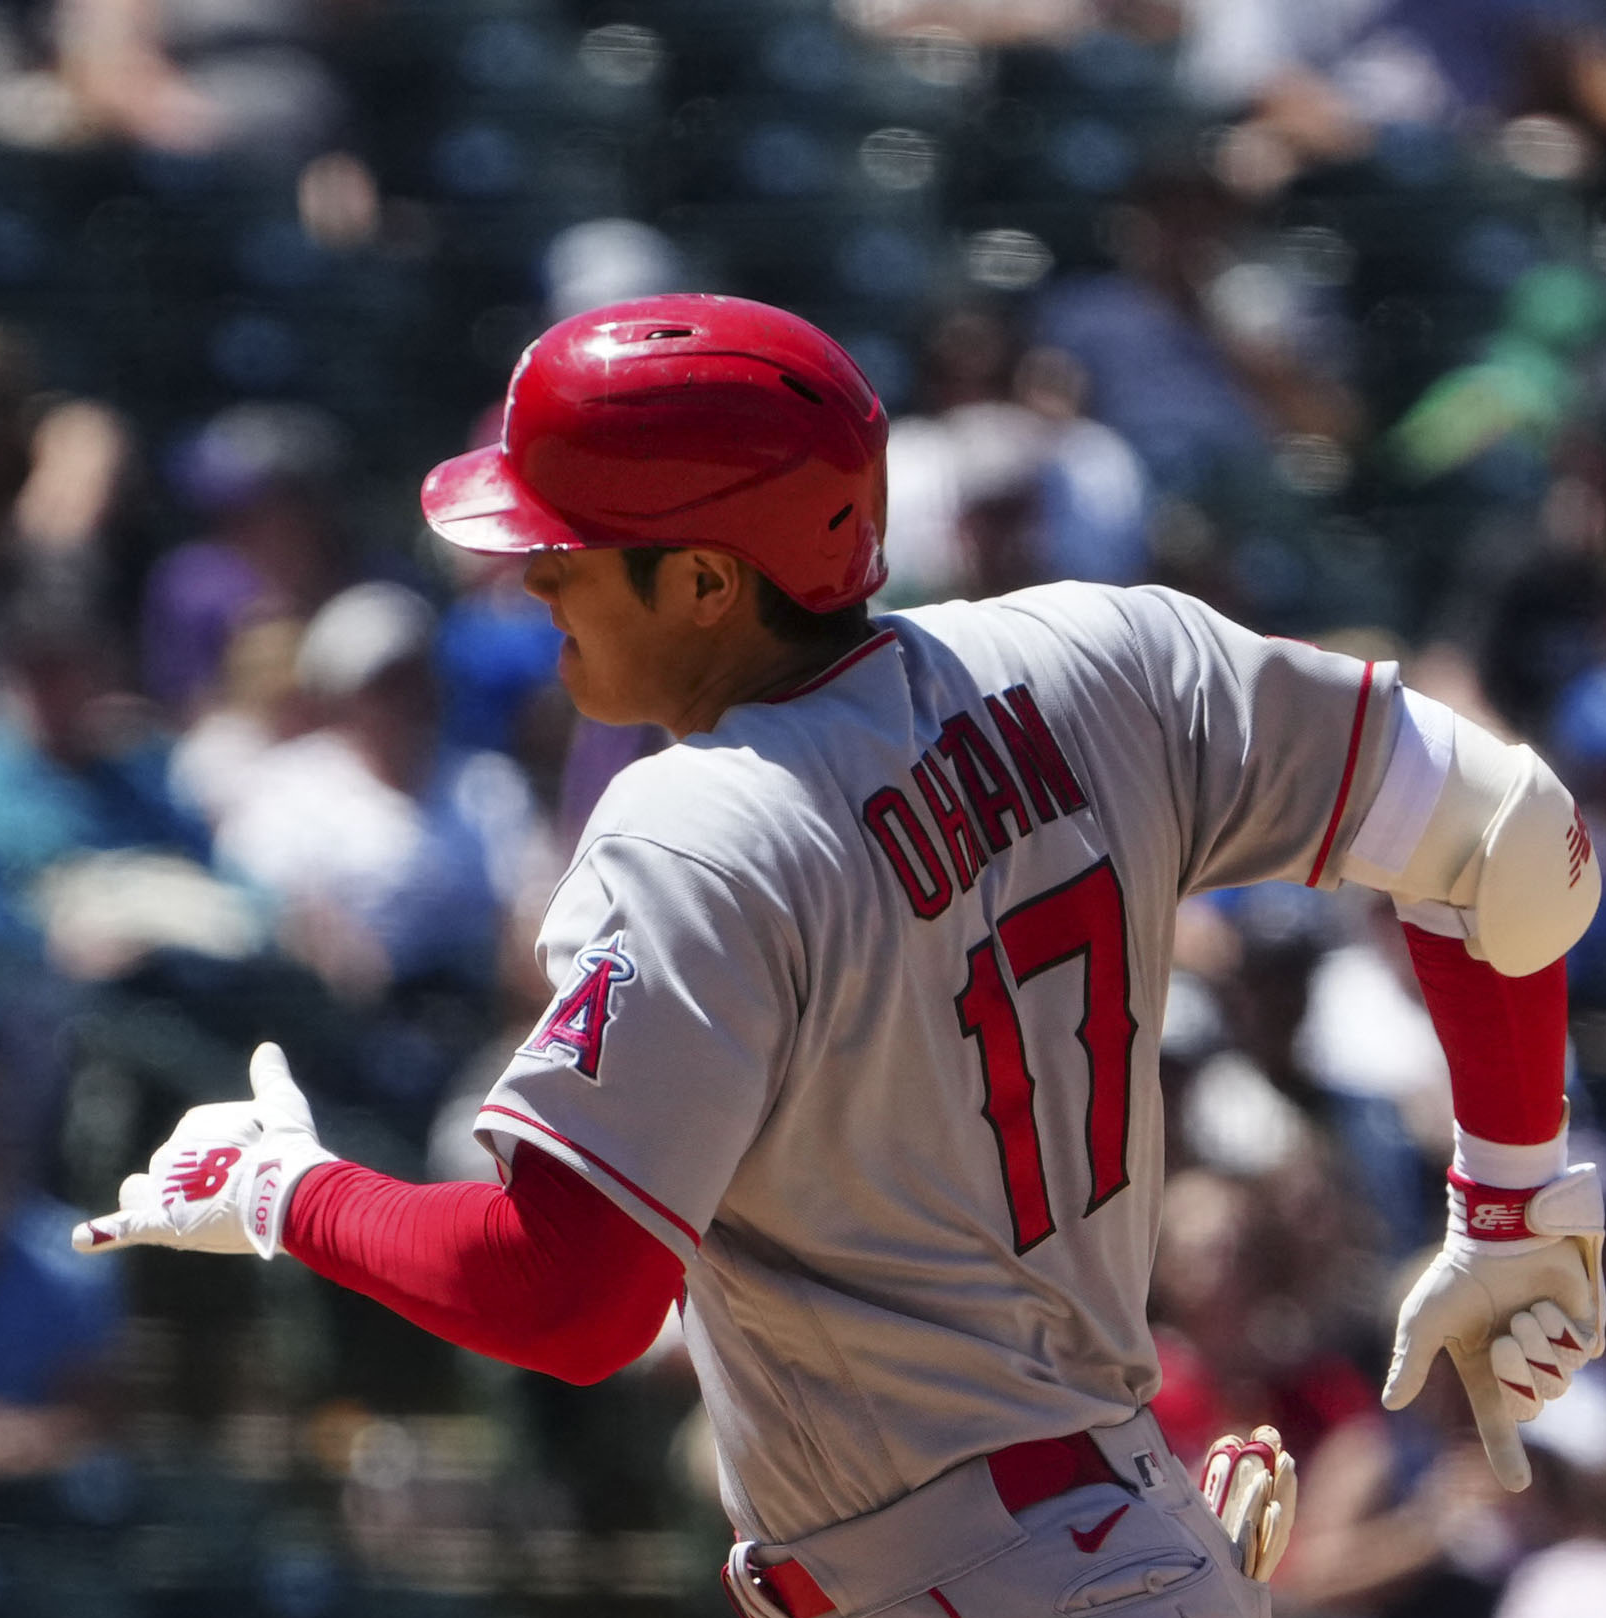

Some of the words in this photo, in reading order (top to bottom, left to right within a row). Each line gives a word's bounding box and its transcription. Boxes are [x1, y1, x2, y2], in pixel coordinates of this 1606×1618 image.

[520, 946, 617, 1084] A
[954, 853, 1138, 1257] 17
[255, 1179, 277, 1237] SO17
